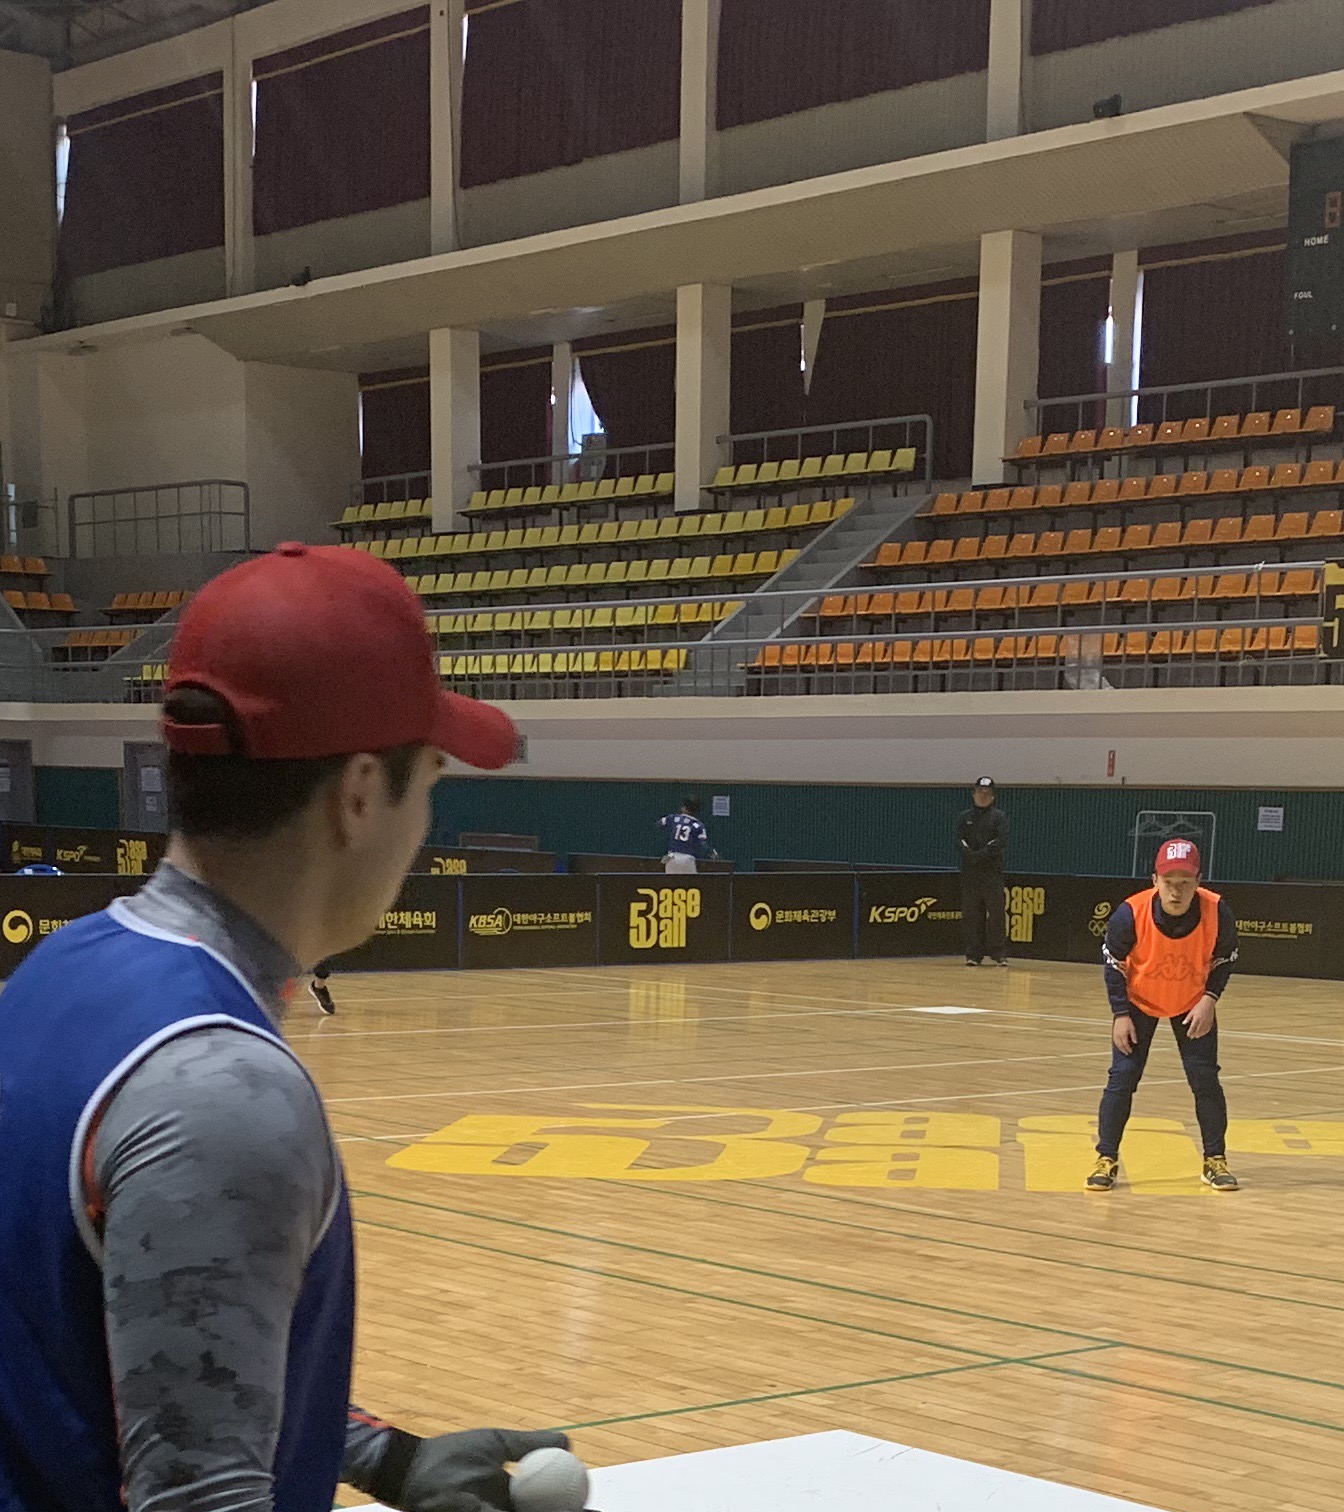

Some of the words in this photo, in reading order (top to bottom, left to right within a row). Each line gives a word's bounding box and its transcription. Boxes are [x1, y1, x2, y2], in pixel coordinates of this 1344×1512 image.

[1304, 235, 1329, 246] HOME
[674, 823, 691, 842] 13
[469, 914, 503, 928] KBSA
[868, 904, 920, 923] KSPO
